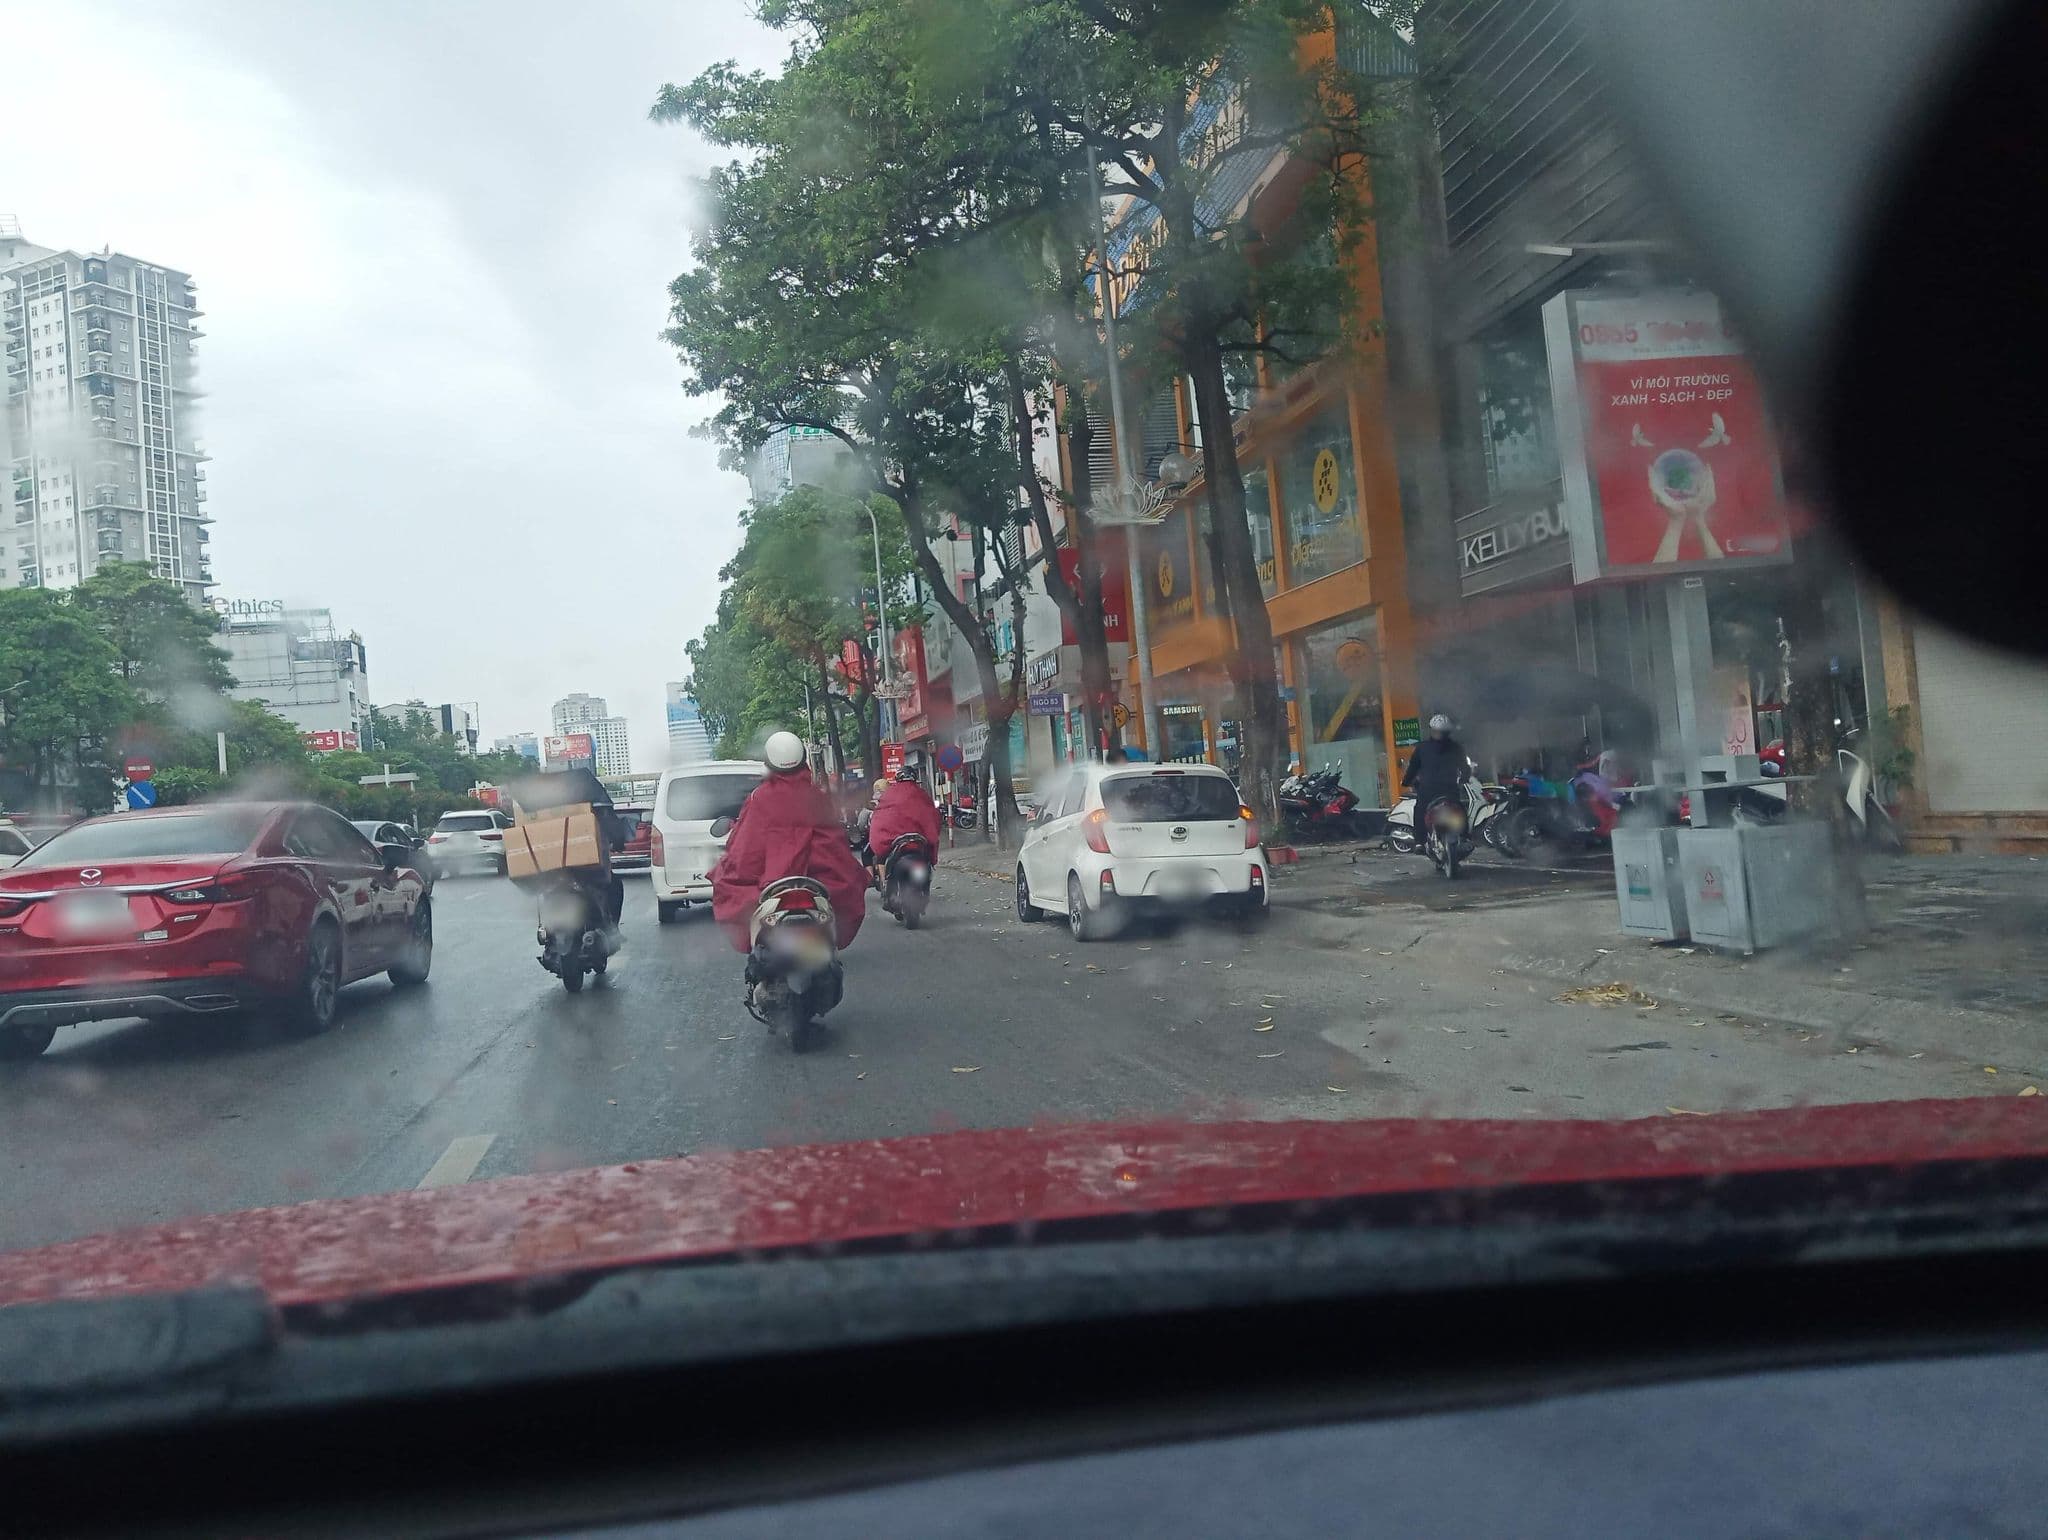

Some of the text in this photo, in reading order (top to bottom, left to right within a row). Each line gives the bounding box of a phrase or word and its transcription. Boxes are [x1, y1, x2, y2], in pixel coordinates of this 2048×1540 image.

[1630, 372, 1730, 389] VÌ MÔI TRƯỜNG
[1611, 395, 1648, 407] XANH
[1659, 391, 1696, 406] SẠCH
[1706, 389, 1733, 403] ĐẸP
[1463, 503, 1569, 568] KELLYBU
[1163, 705, 1204, 716] SAMSUNG
